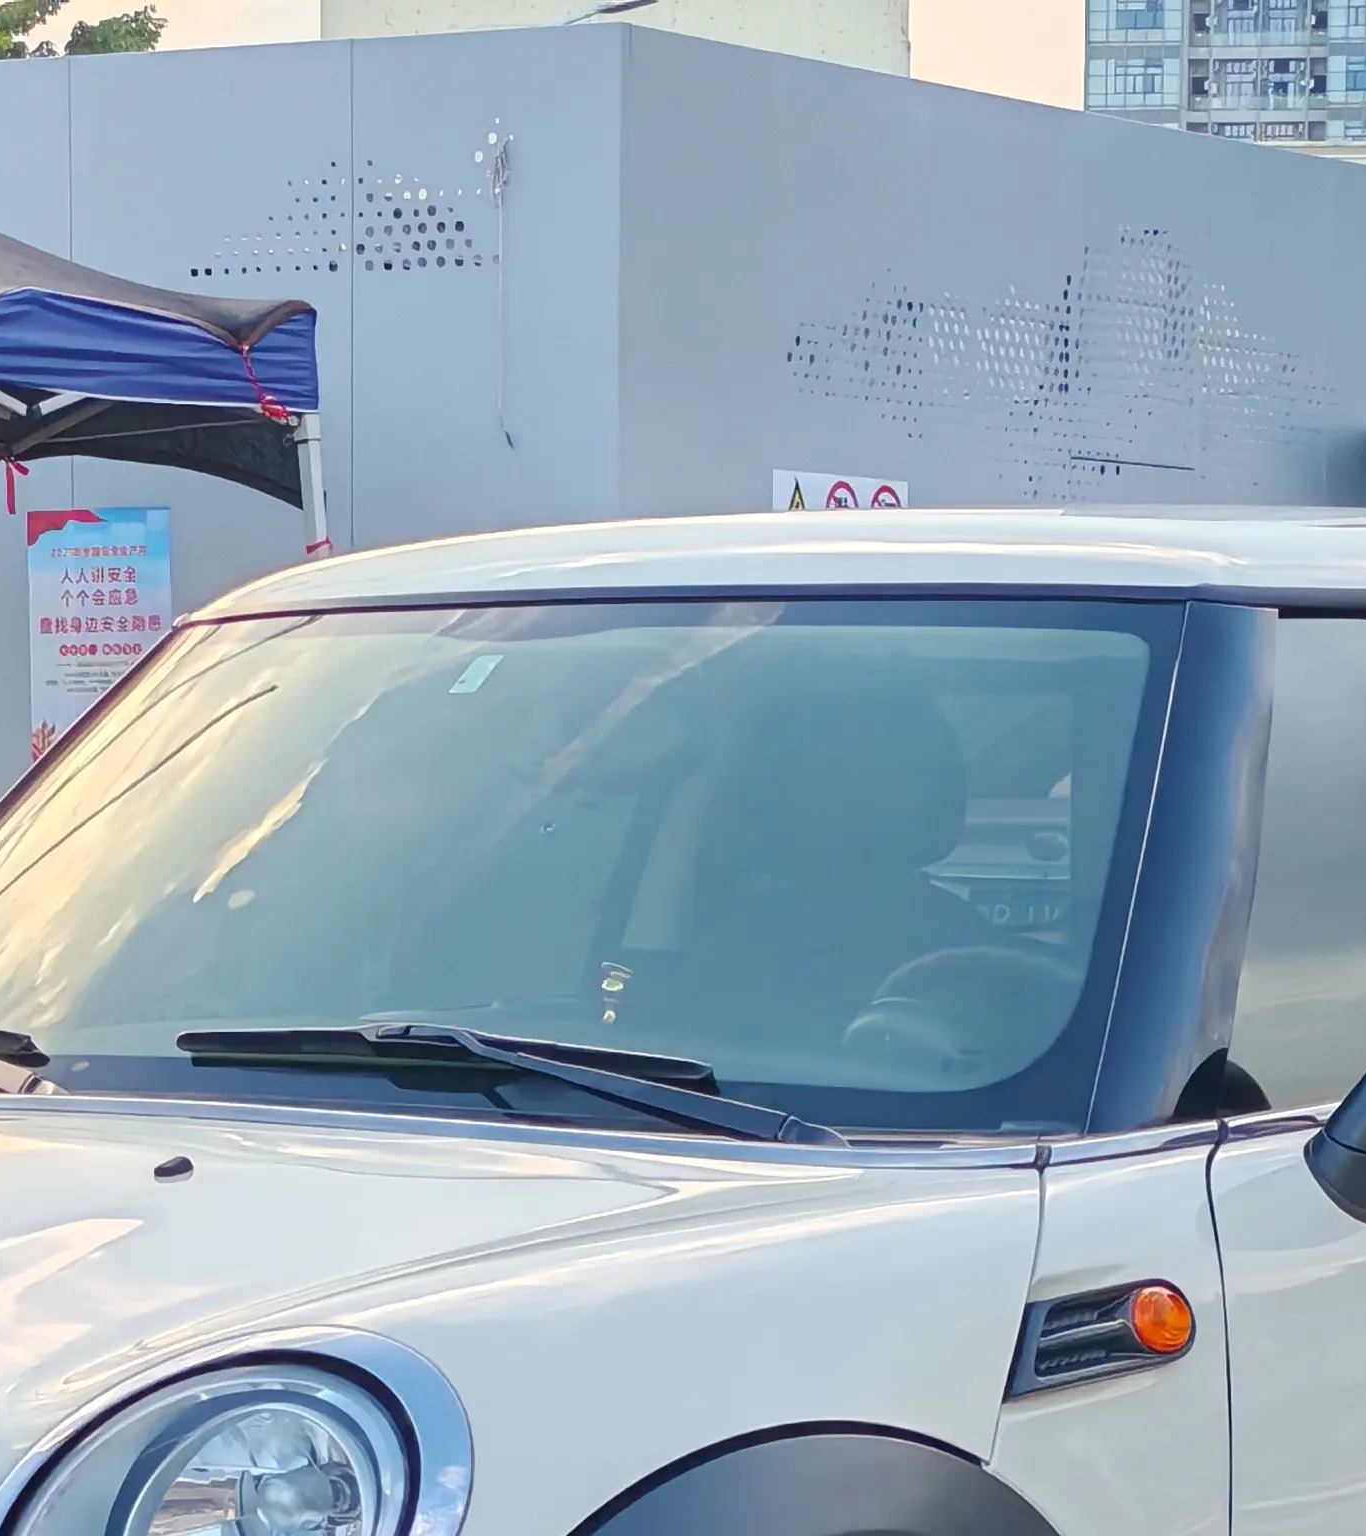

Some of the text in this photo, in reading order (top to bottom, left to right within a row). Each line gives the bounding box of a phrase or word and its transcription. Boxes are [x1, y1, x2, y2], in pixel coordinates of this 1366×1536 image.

[60, 566, 137, 585] 人人讲安全
[60, 588, 139, 607] 个个会应急
